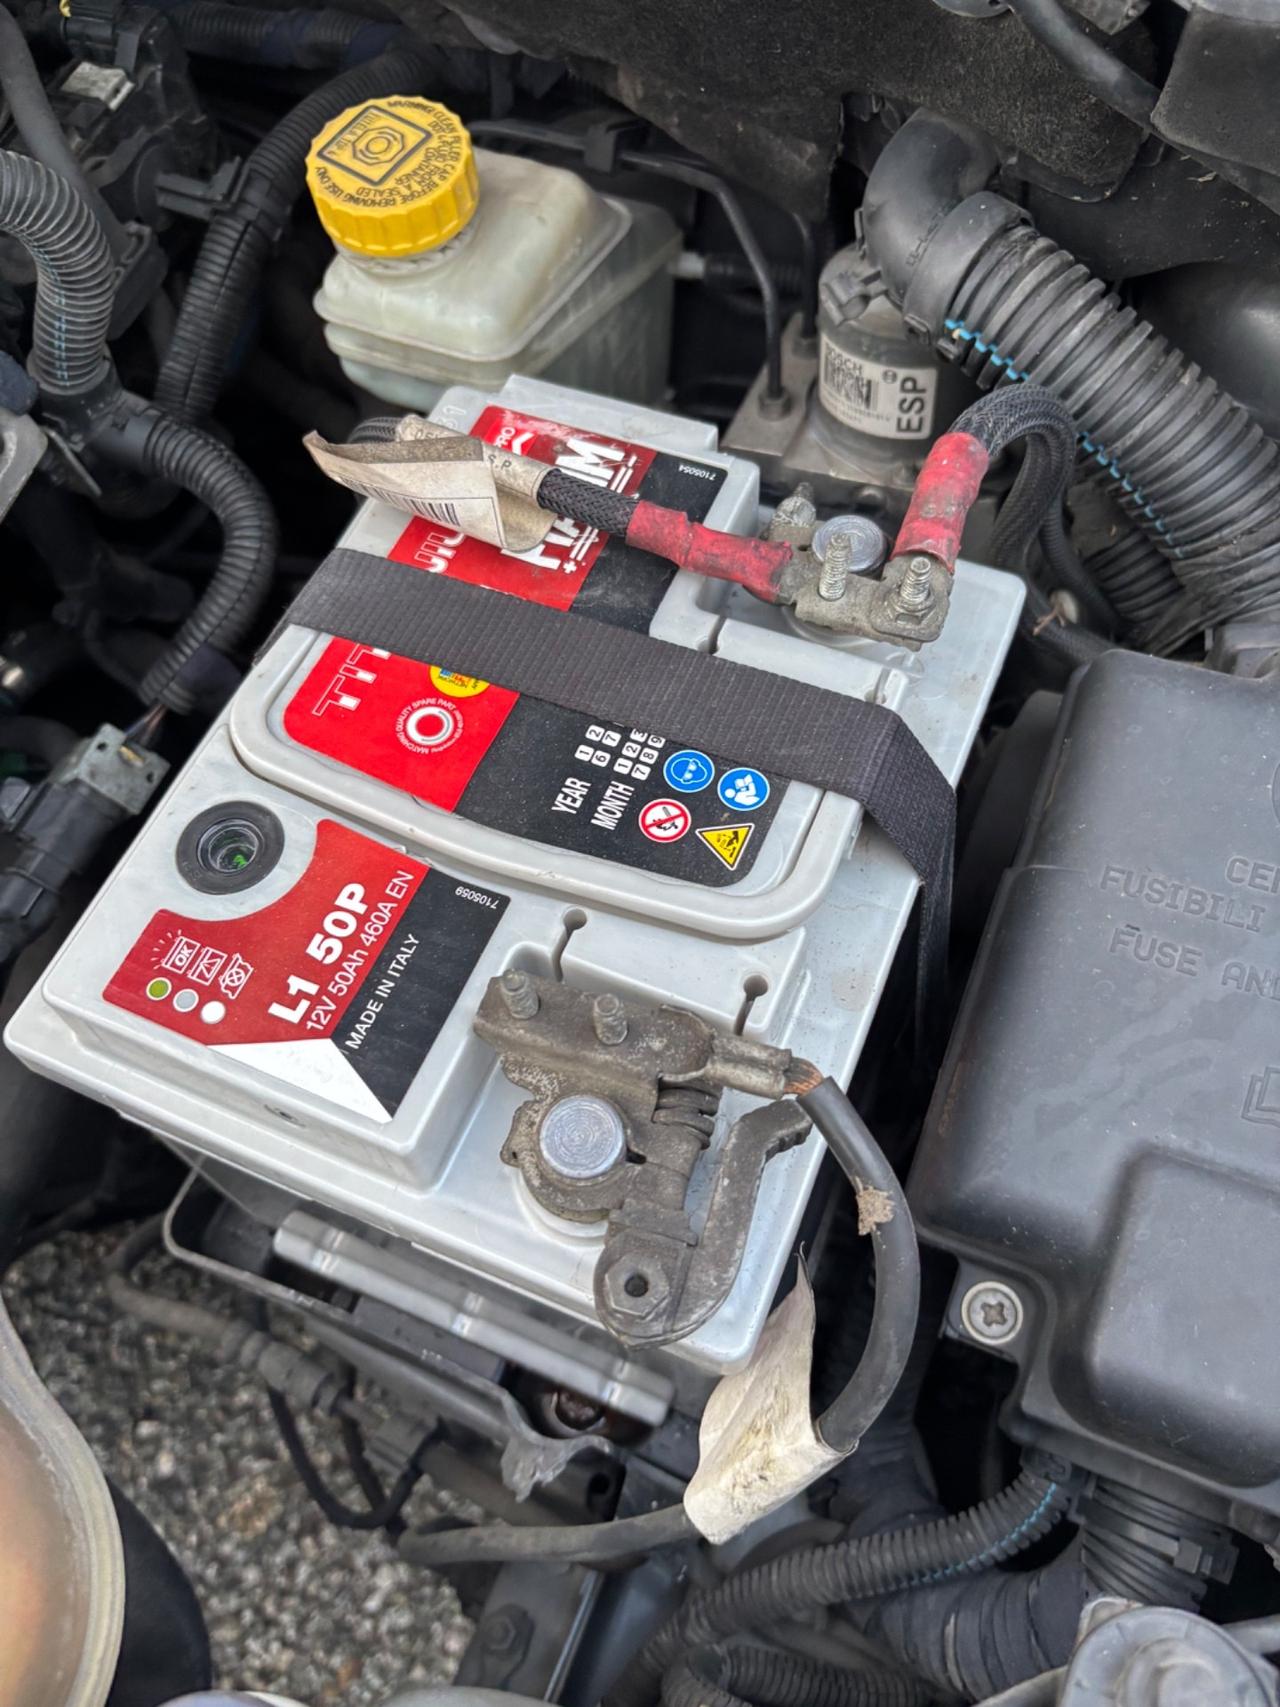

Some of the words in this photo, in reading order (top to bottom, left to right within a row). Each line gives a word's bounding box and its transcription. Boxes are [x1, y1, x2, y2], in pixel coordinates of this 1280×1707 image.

[896, 376, 927, 433] ESP
[412, 697, 437, 710] SPARE
[437, 697, 457, 712] PART
[551, 777, 592, 814] YEAR
[590, 780, 635, 831] MONTH
[454, 884, 500, 910] 7105059
[1099, 864, 1267, 934] FUSIBILI
[1225, 856, 1280, 896] CE
[173, 945, 194, 969] OK
[267, 974, 320, 1026] L1
[305, 881, 369, 967] 50P
[306, 998, 338, 1032] 12V
[331, 950, 370, 996] 50Ah
[361, 902, 398, 949] 460A
[385, 870, 416, 900] EN
[1109, 927, 1204, 978] FUSE
[347, 1001, 381, 1052] MADE
[374, 980, 395, 1004] IN
[388, 933, 420, 980] ITALY
